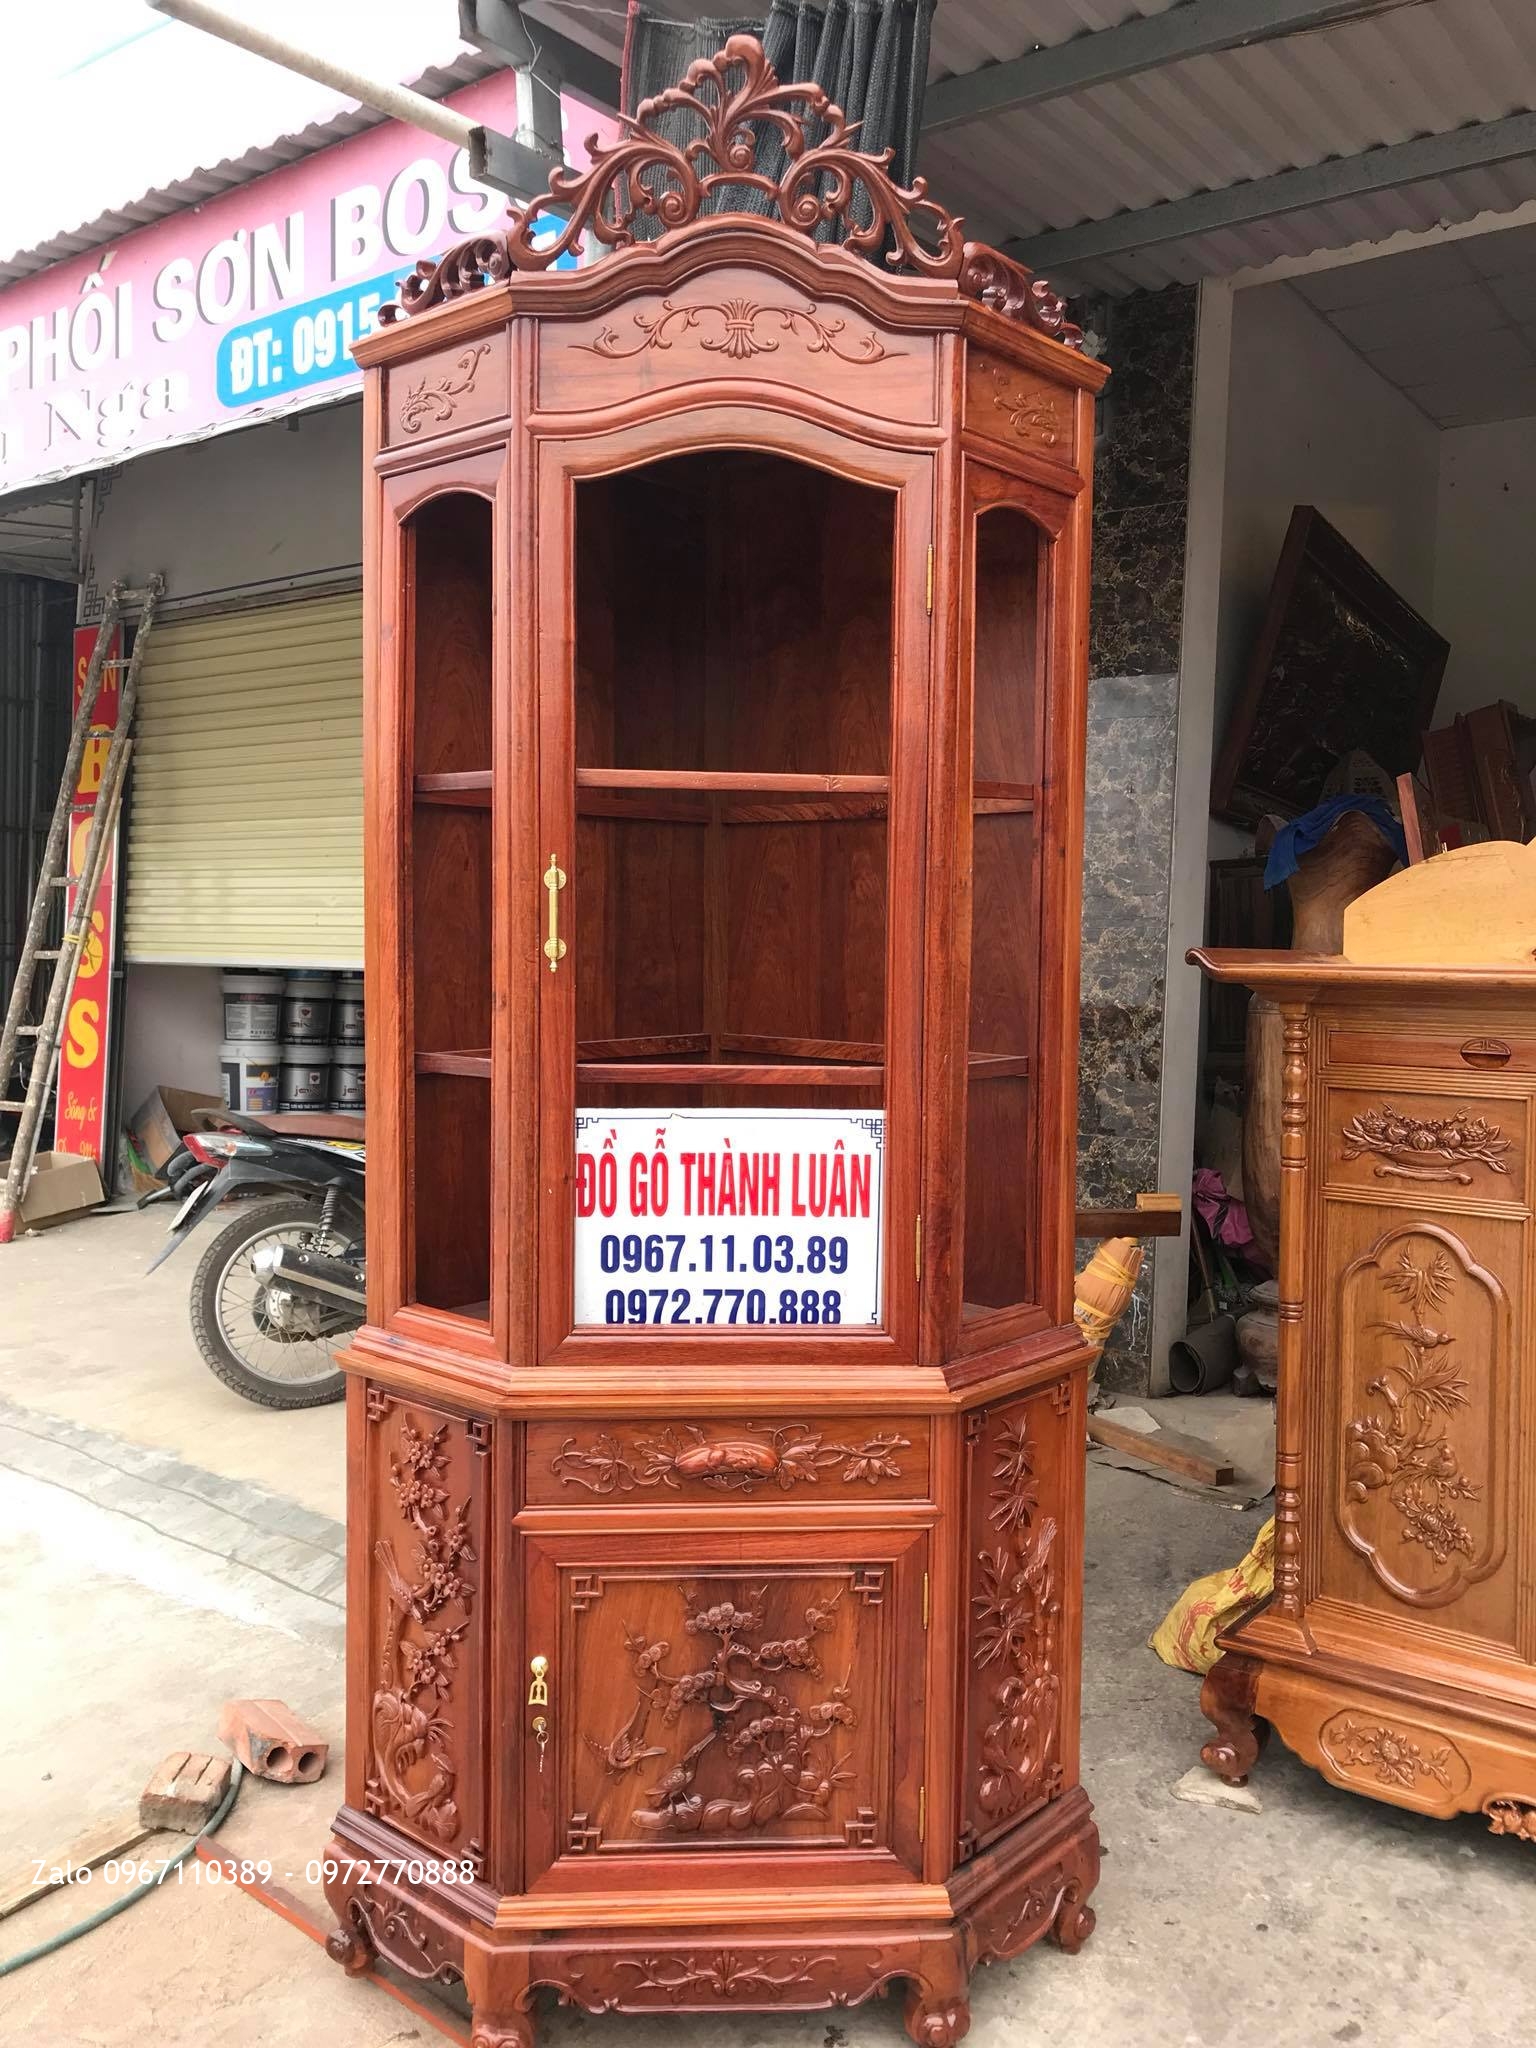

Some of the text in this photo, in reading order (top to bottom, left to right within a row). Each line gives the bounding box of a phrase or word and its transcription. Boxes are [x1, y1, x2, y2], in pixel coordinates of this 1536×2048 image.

[0, 250, 133, 388] PHỐI
[153, 211, 304, 345] SƠN
[231, 327, 284, 396] ĐT:
[76, 651, 117, 699] SN
[576, 1128, 871, 1218] ĐỒ GỖ THÀNH LUÂN
[600, 1234, 848, 1274] 0967.11.03.89
[605, 1288, 842, 1324] 0972.770.888
